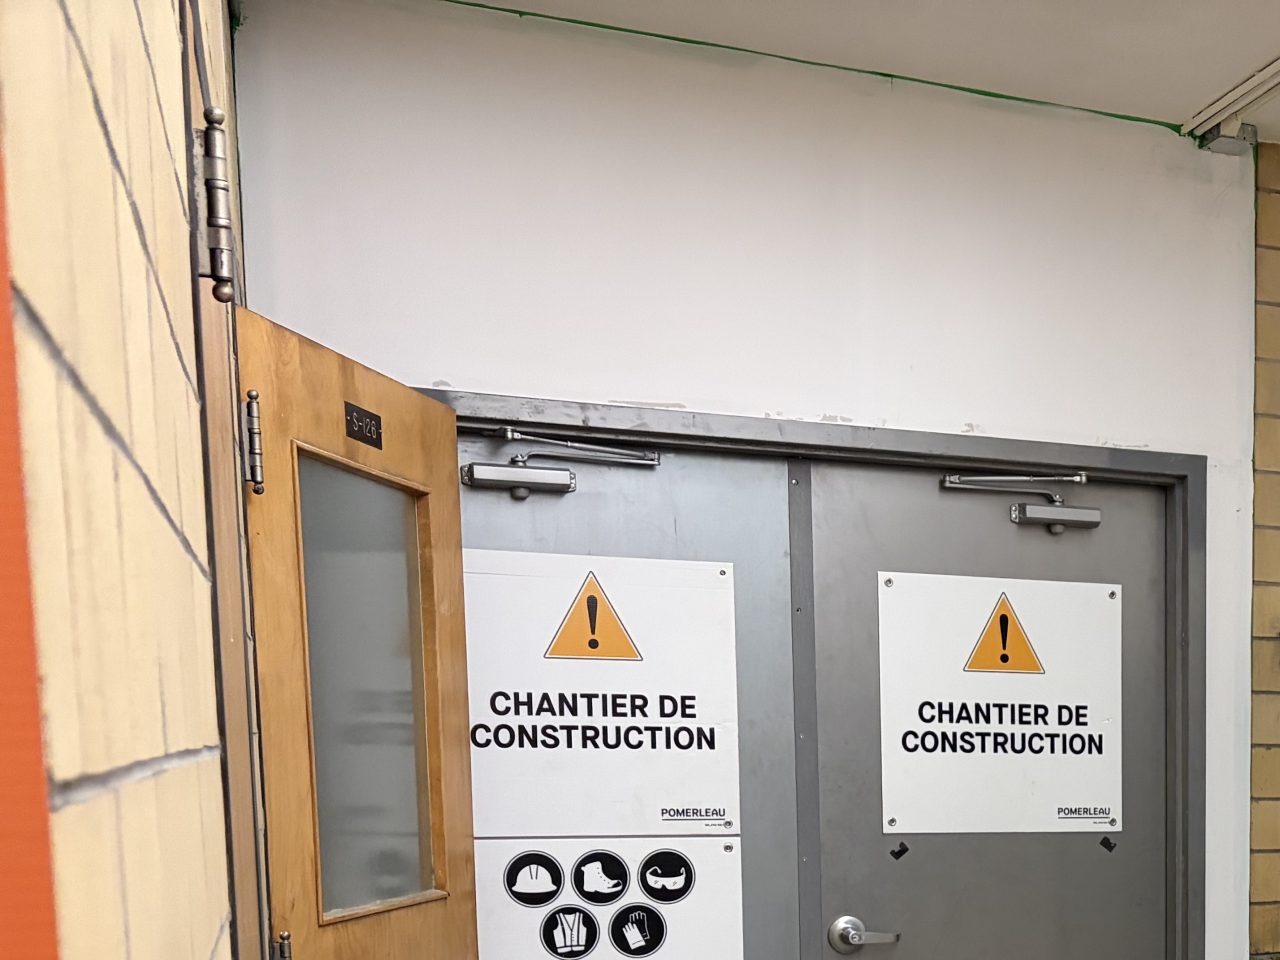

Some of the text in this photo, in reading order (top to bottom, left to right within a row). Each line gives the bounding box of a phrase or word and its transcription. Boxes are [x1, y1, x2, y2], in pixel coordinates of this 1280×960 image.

[352, 412, 377, 439] S-126
[489, 691, 697, 719] CHANTIER DE
[917, 701, 1088, 727] CHANTIER DE
[470, 723, 716, 750] CONSTRUCTION
[901, 730, 1104, 755] CONSTRUCTION
[661, 808, 726, 817] POMERLEAU
[1057, 807, 1111, 816] POMERLEAU
